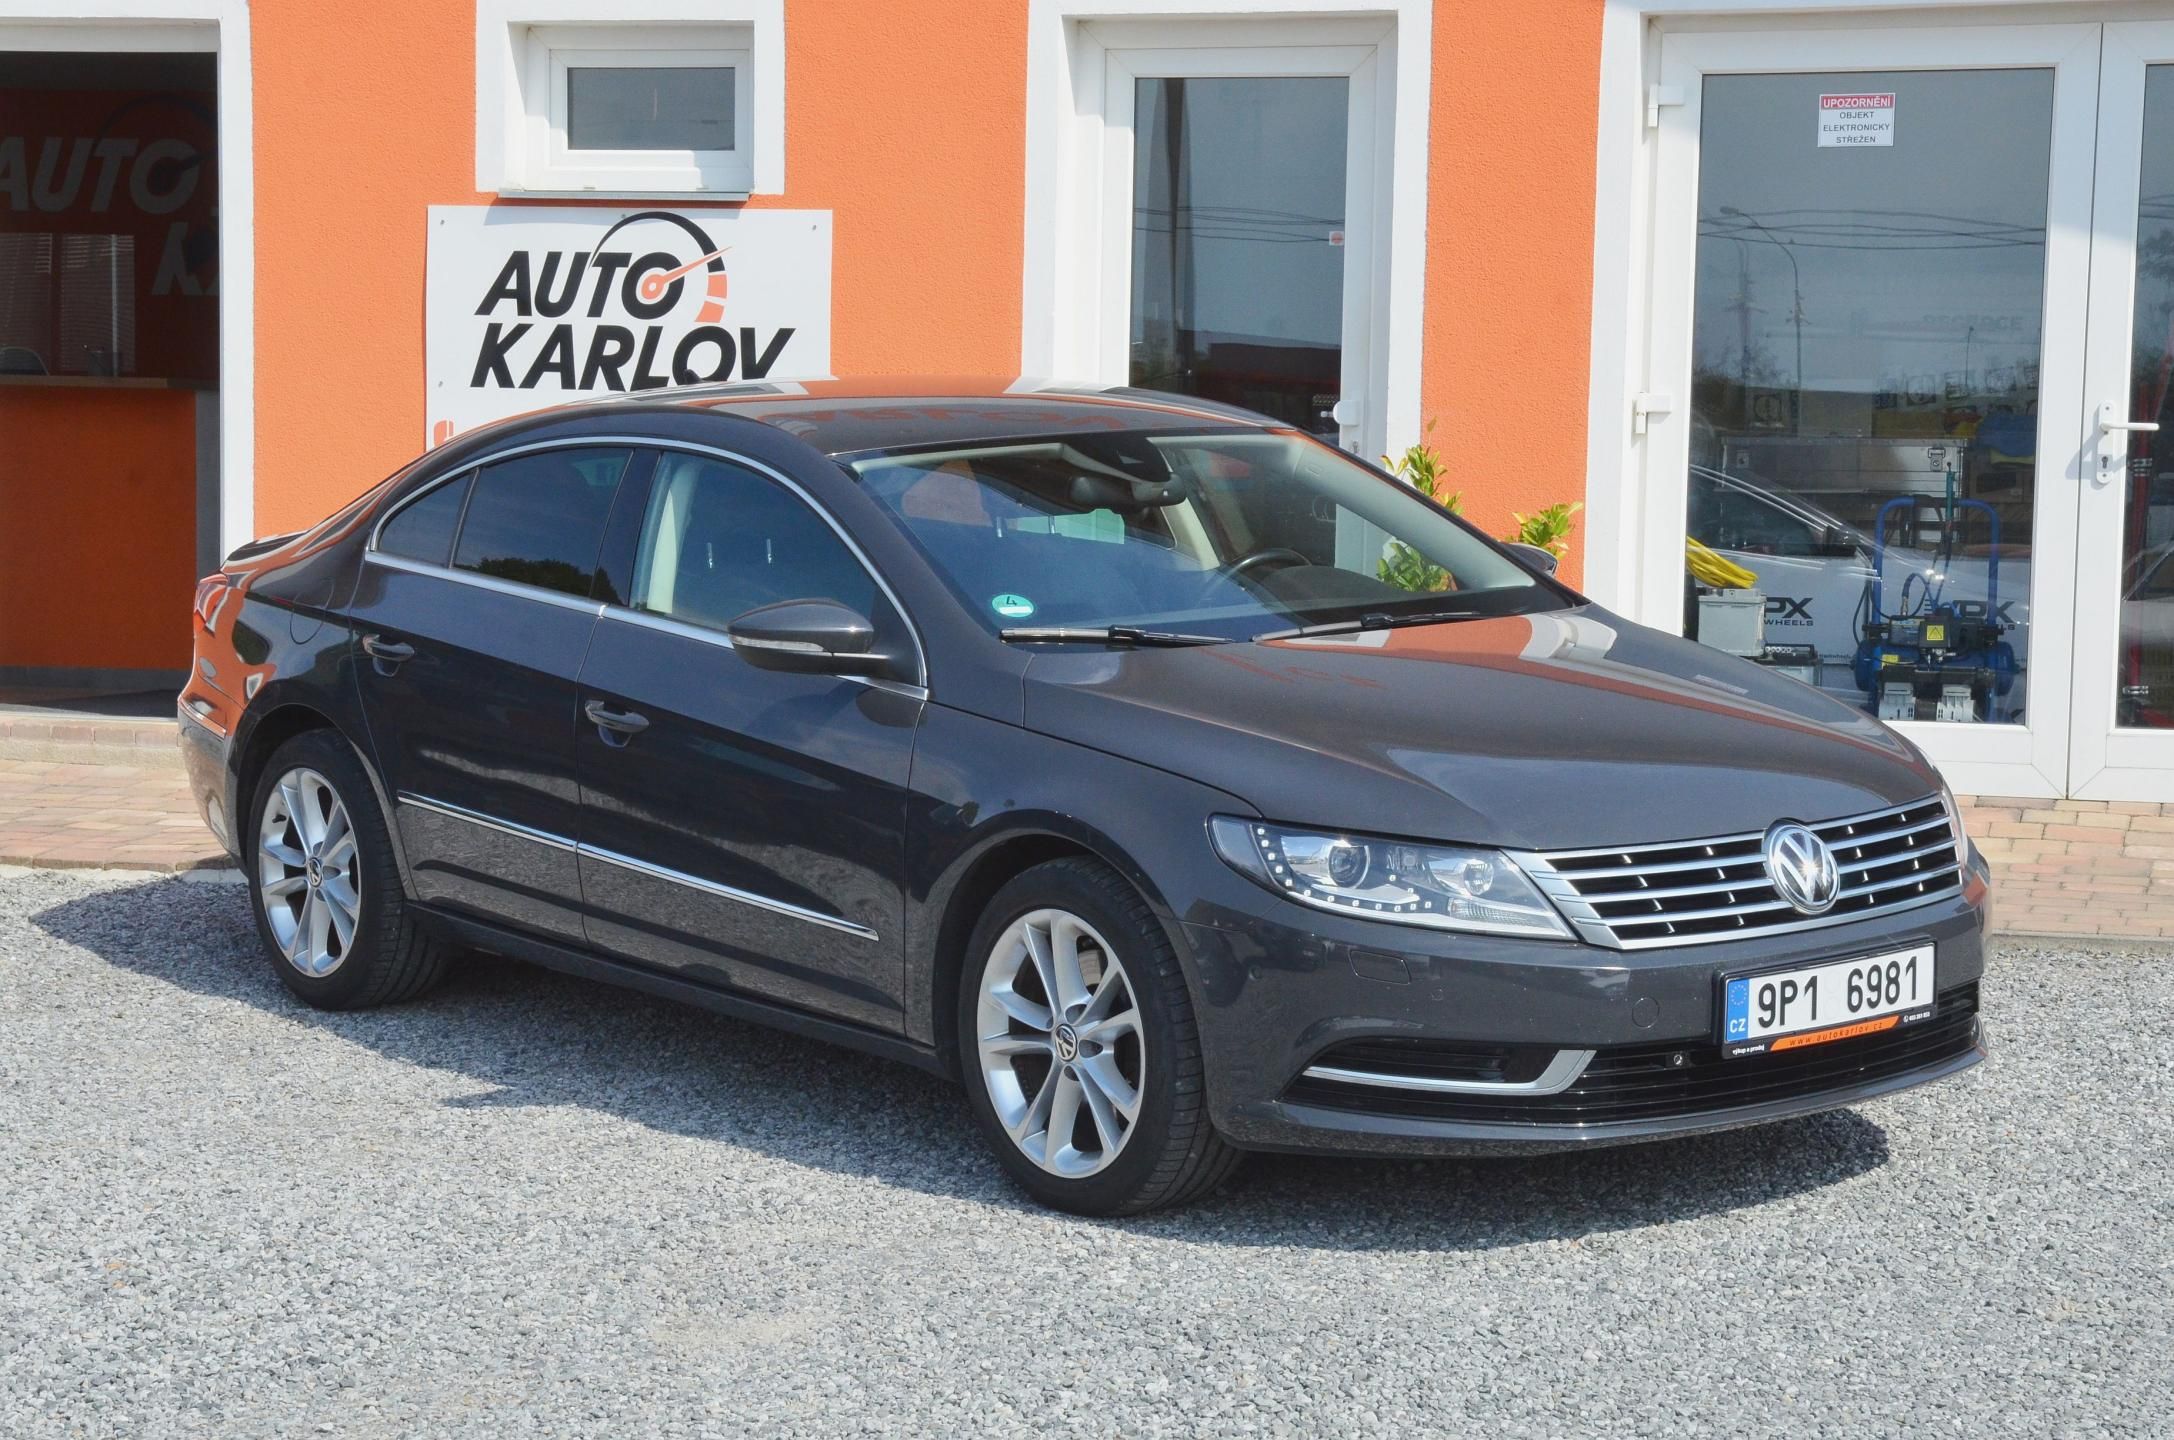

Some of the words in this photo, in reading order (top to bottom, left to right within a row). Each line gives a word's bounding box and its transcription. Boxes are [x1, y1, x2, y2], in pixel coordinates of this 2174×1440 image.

[1823, 95, 1891, 108] UPOZORNĚNÍ
[1839, 111, 1875, 119] OBJEKT
[1823, 123, 1890, 132] ELEKTRONICKY
[1836, 136, 1876, 144] STŘEŽEN
[0, 136, 201, 215] AUTO
[474, 250, 686, 321] AUTO
[470, 322, 797, 392] KARLOV
[1757, 975, 1818, 1029] 9P1
[1847, 956, 1918, 1013] 6981
[1729, 1018, 1746, 1033] CZ
